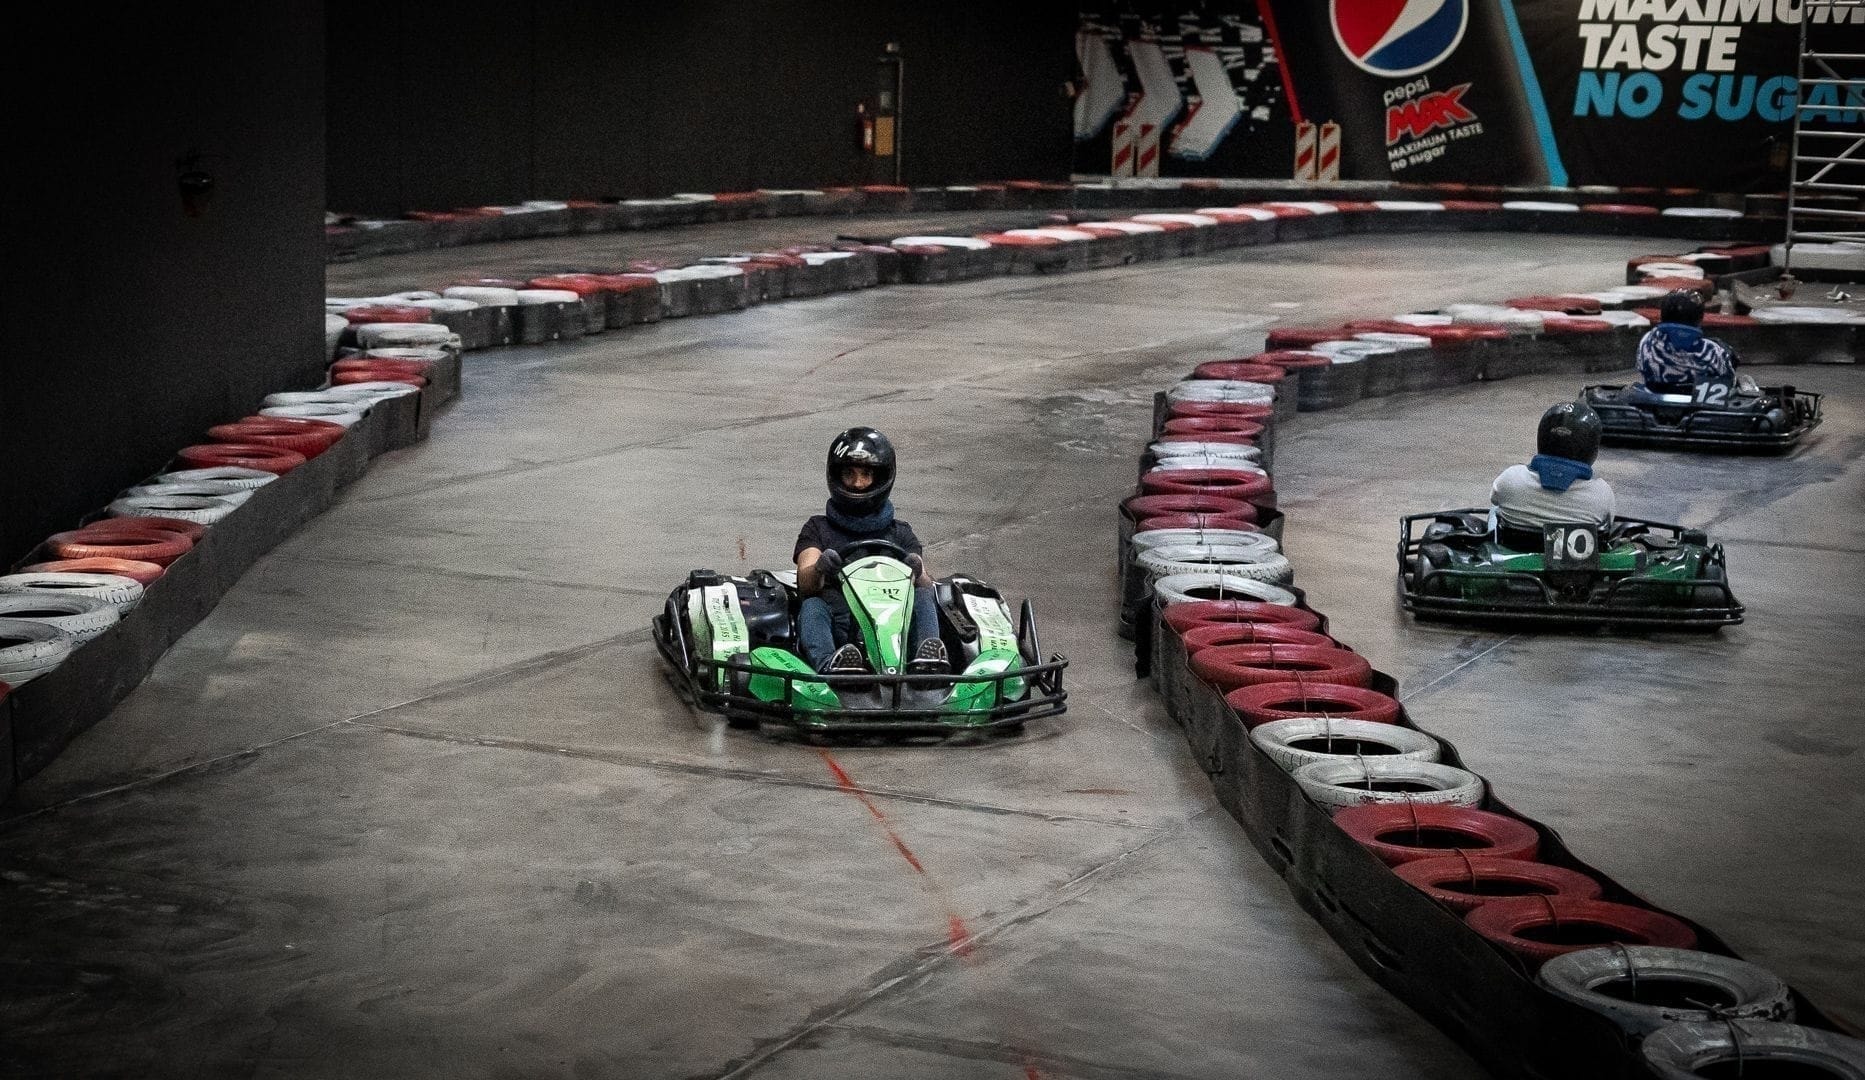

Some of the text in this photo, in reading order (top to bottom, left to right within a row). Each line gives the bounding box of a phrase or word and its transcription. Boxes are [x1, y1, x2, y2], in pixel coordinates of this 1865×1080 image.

[1578, 24, 1742, 71] TASTE
[1383, 75, 1430, 106] pepsi
[1573, 71, 1663, 119] NO
[1388, 122, 1484, 160] MAXIMUM TASTE
[1391, 145, 1446, 171] no sugar
[1695, 382, 1728, 406] 12
[1546, 527, 1595, 561] 10
